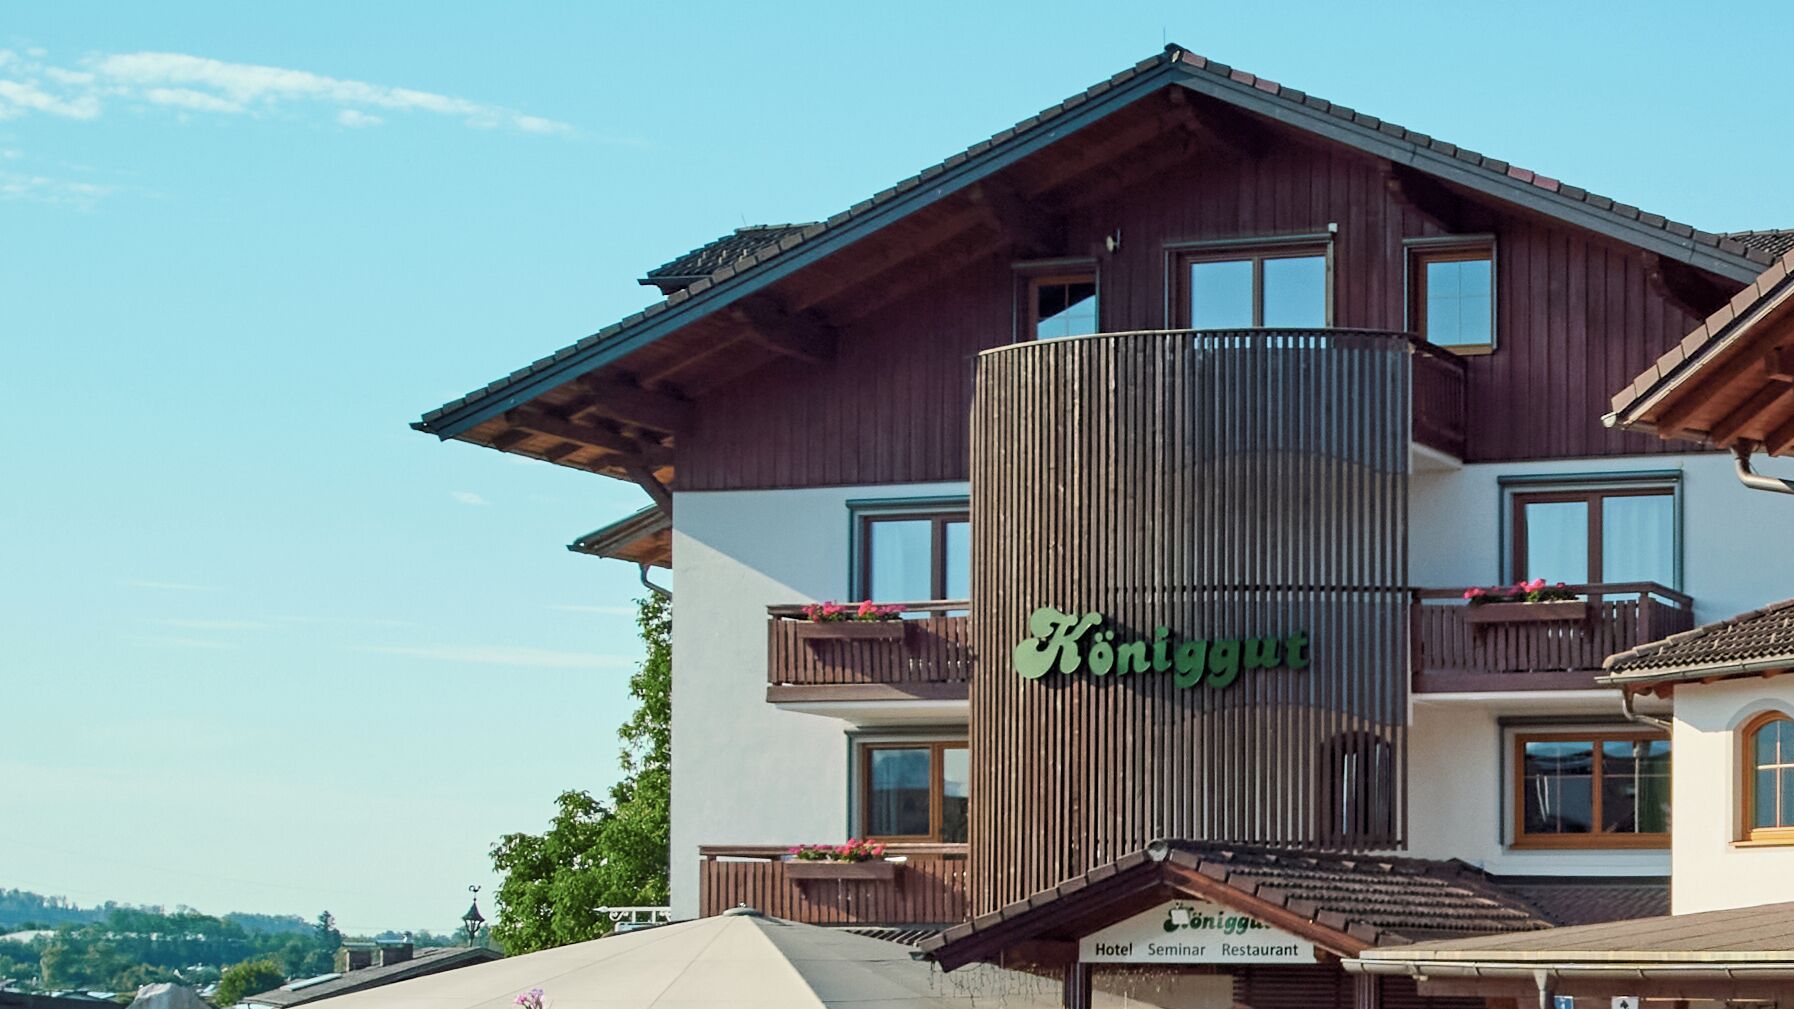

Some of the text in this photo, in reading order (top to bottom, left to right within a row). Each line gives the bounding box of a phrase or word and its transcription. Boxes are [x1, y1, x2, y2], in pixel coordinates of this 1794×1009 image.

[1014, 606, 1309, 689] Königgut
[1163, 903, 1270, 935] öniggu
[1096, 942, 1299, 956] Hotel Seminar Restaurant
